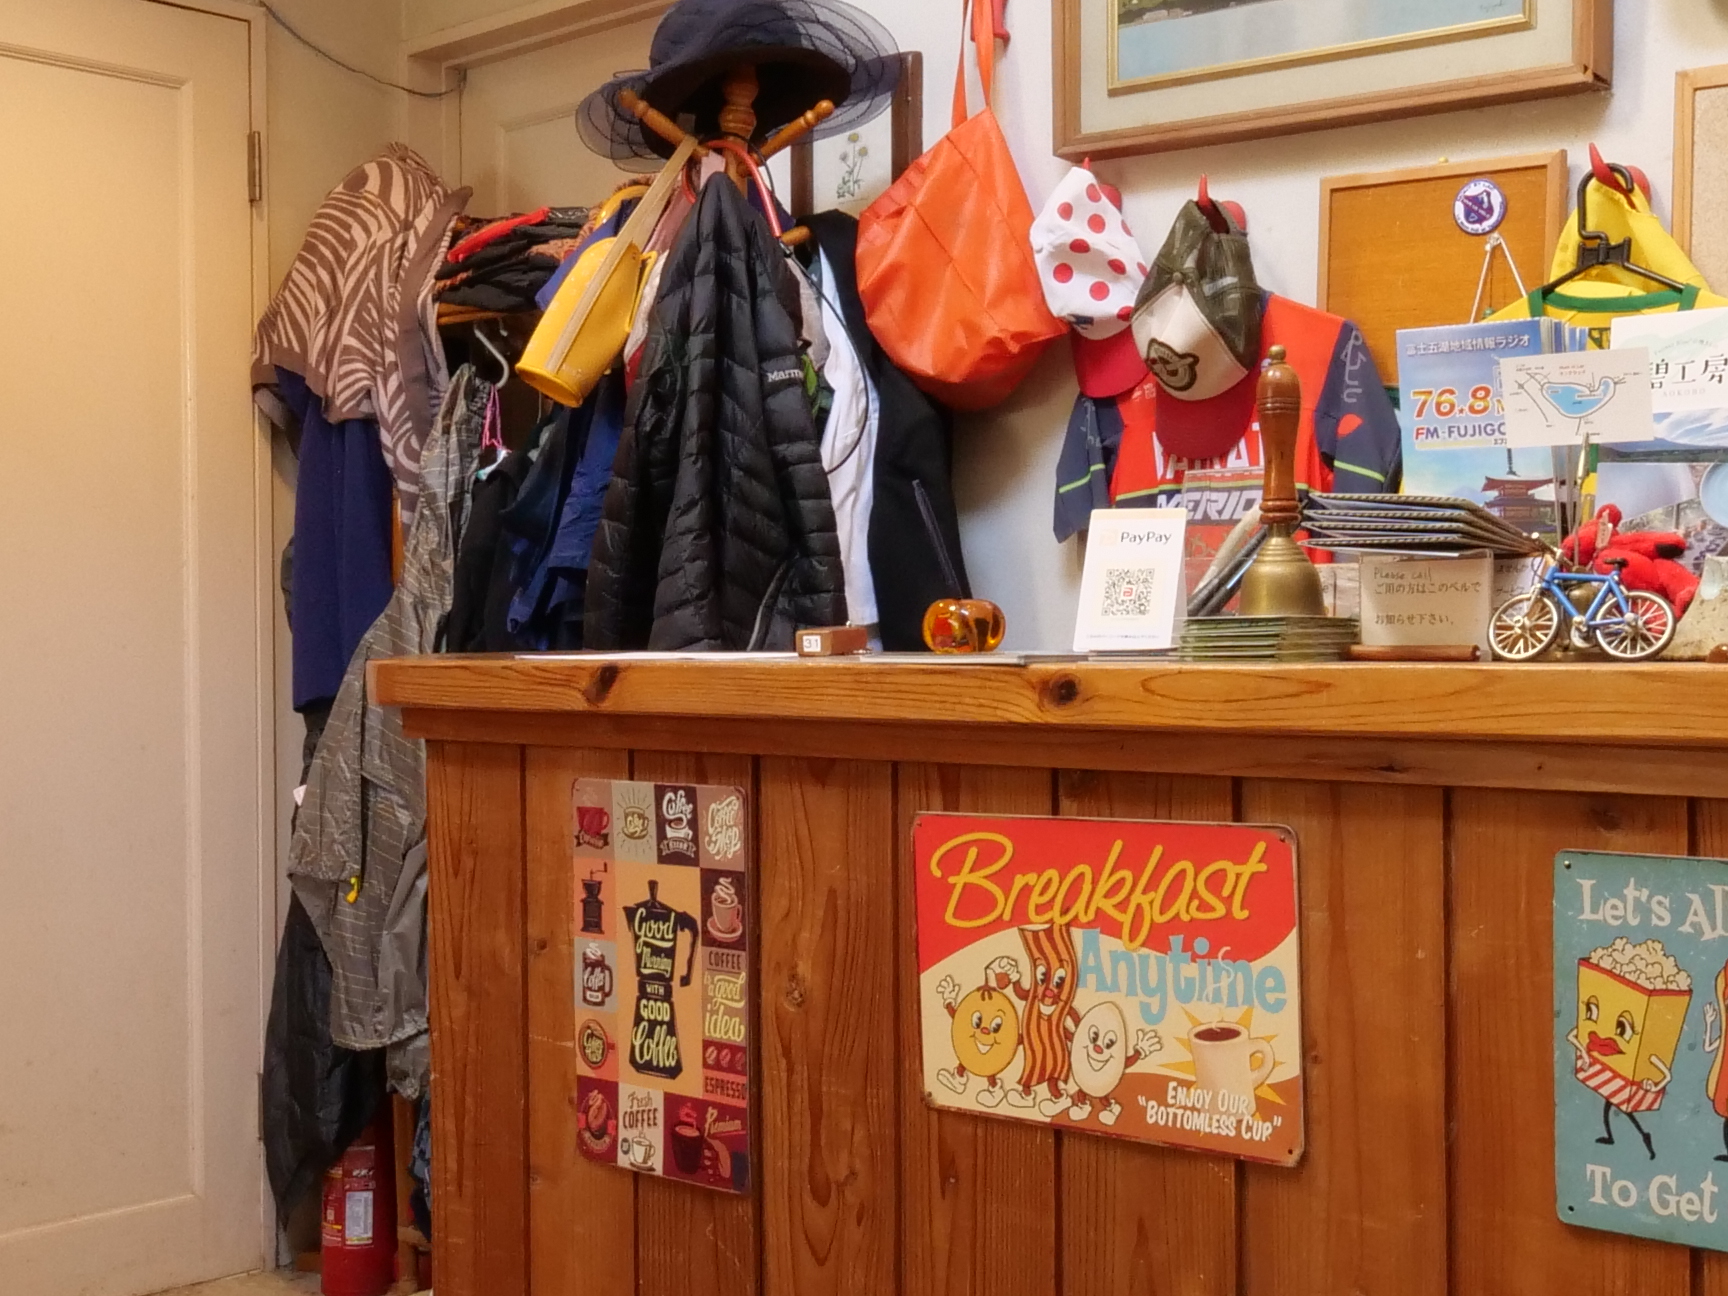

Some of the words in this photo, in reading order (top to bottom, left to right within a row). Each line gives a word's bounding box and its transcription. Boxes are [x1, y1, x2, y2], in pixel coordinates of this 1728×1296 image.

[766, 369, 804, 383] Marm
[1156, 489, 1266, 521] MERID
[1120, 531, 1172, 545] PayPay
[804, 638, 819, 649] 31
[930, 832, 1267, 950] Breakfast
[1577, 879, 1672, 927] Let's
[635, 908, 675, 953] Good
[708, 950, 741, 970] COFFEE
[645, 984, 665, 996] WITH
[1077, 928, 1287, 1026] Anytime
[639, 999, 671, 1022] GOOD
[705, 1004, 746, 1042] idea
[632, 1022, 678, 1068] Coffee
[704, 1077, 747, 1100] ESPRESSO
[623, 1108, 659, 1130] COFFEE
[1585, 1163, 1638, 1208] To
[1648, 1171, 1719, 1220] Get
